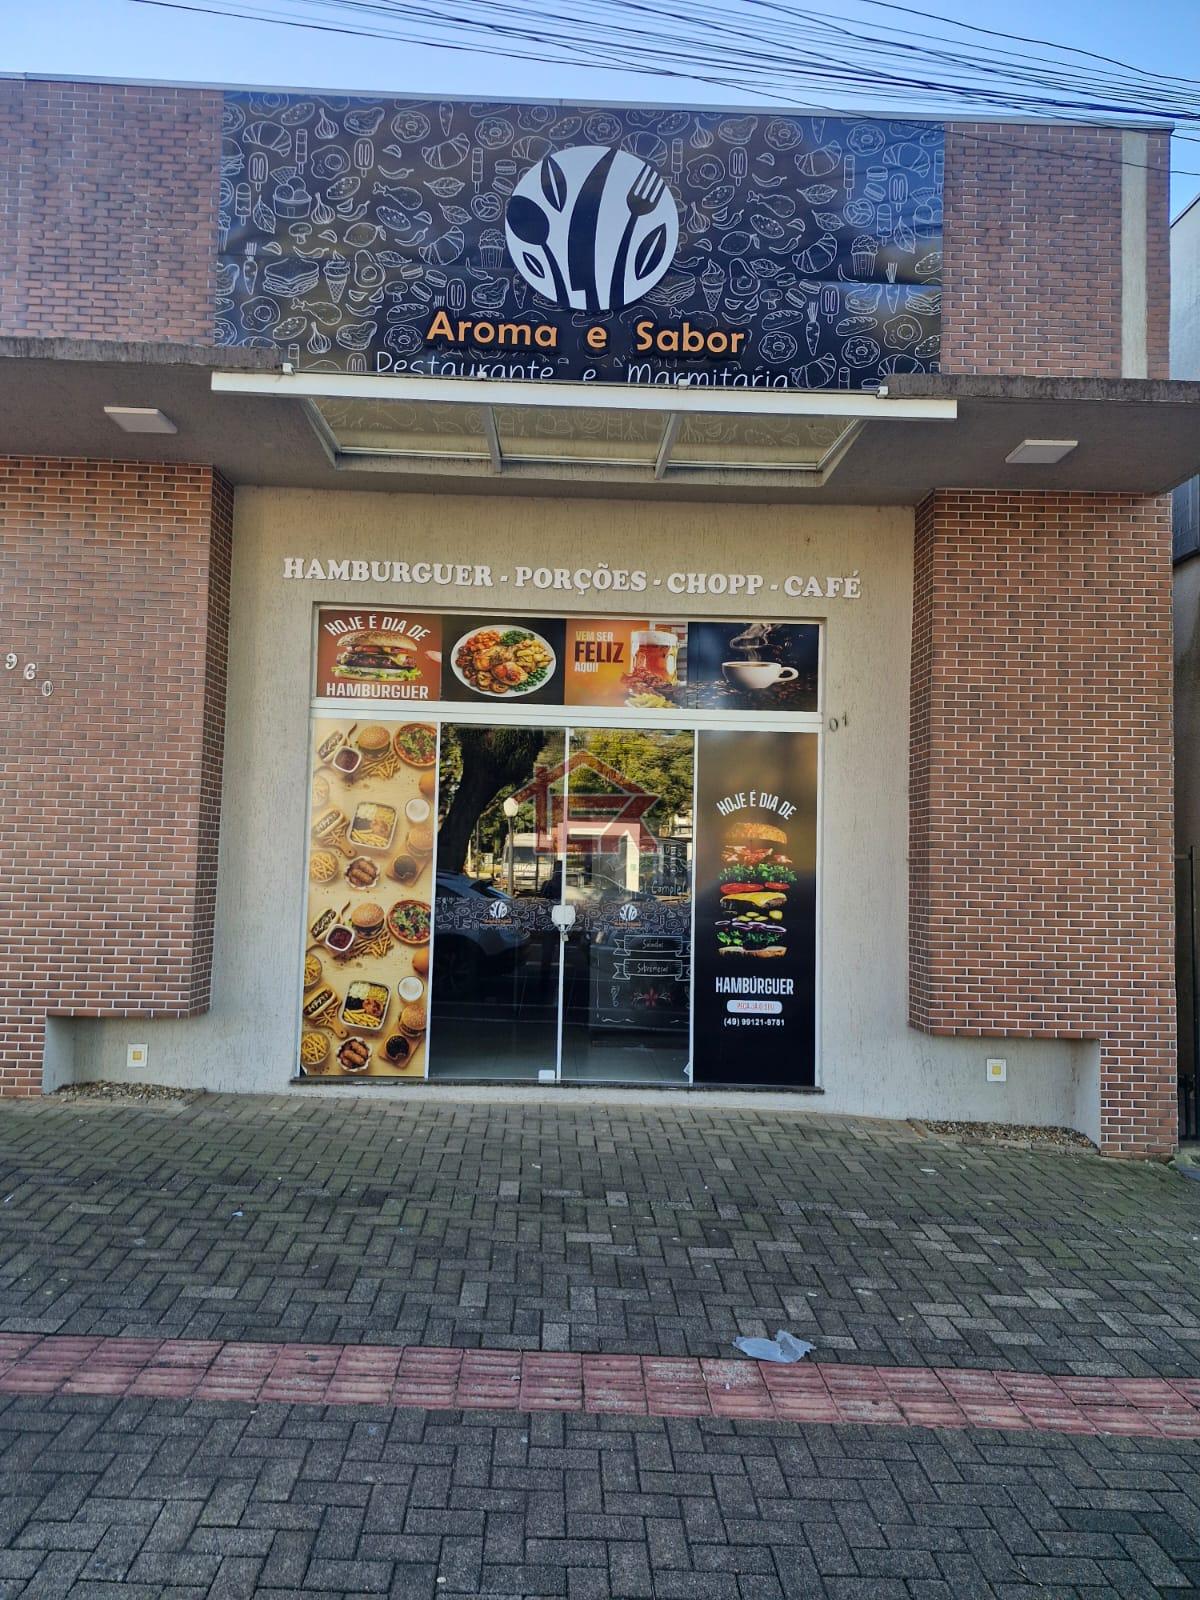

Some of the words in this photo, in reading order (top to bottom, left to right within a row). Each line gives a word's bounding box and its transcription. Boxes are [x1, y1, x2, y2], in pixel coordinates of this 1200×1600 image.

[426, 311, 558, 348] Aroma
[587, 325, 607, 348] e
[636, 321, 746, 354] Sabor
[583, 368, 597, 382] e
[283, 557, 493, 587] HAMBURGUER
[515, 563, 647, 594] PORÇÕES
[667, 573, 764, 595] CHOPP
[784, 571, 862, 598] CAFÉ
[324, 616, 365, 636] HOJE
[369, 614, 377, 629] É
[382, 616, 407, 634] DIA
[407, 624, 431, 641] DE
[575, 631, 595, 641] VEM
[596, 631, 614, 641] SER
[575, 640, 624, 663] FELIZ
[5, 653, 54, 697] 960
[716, 792, 747, 816] HOJE
[749, 789, 756, 807] É
[759, 792, 779, 811] DIA
[778, 801, 797, 820] DE
[715, 976, 794, 995] HAMBÚRGUER
